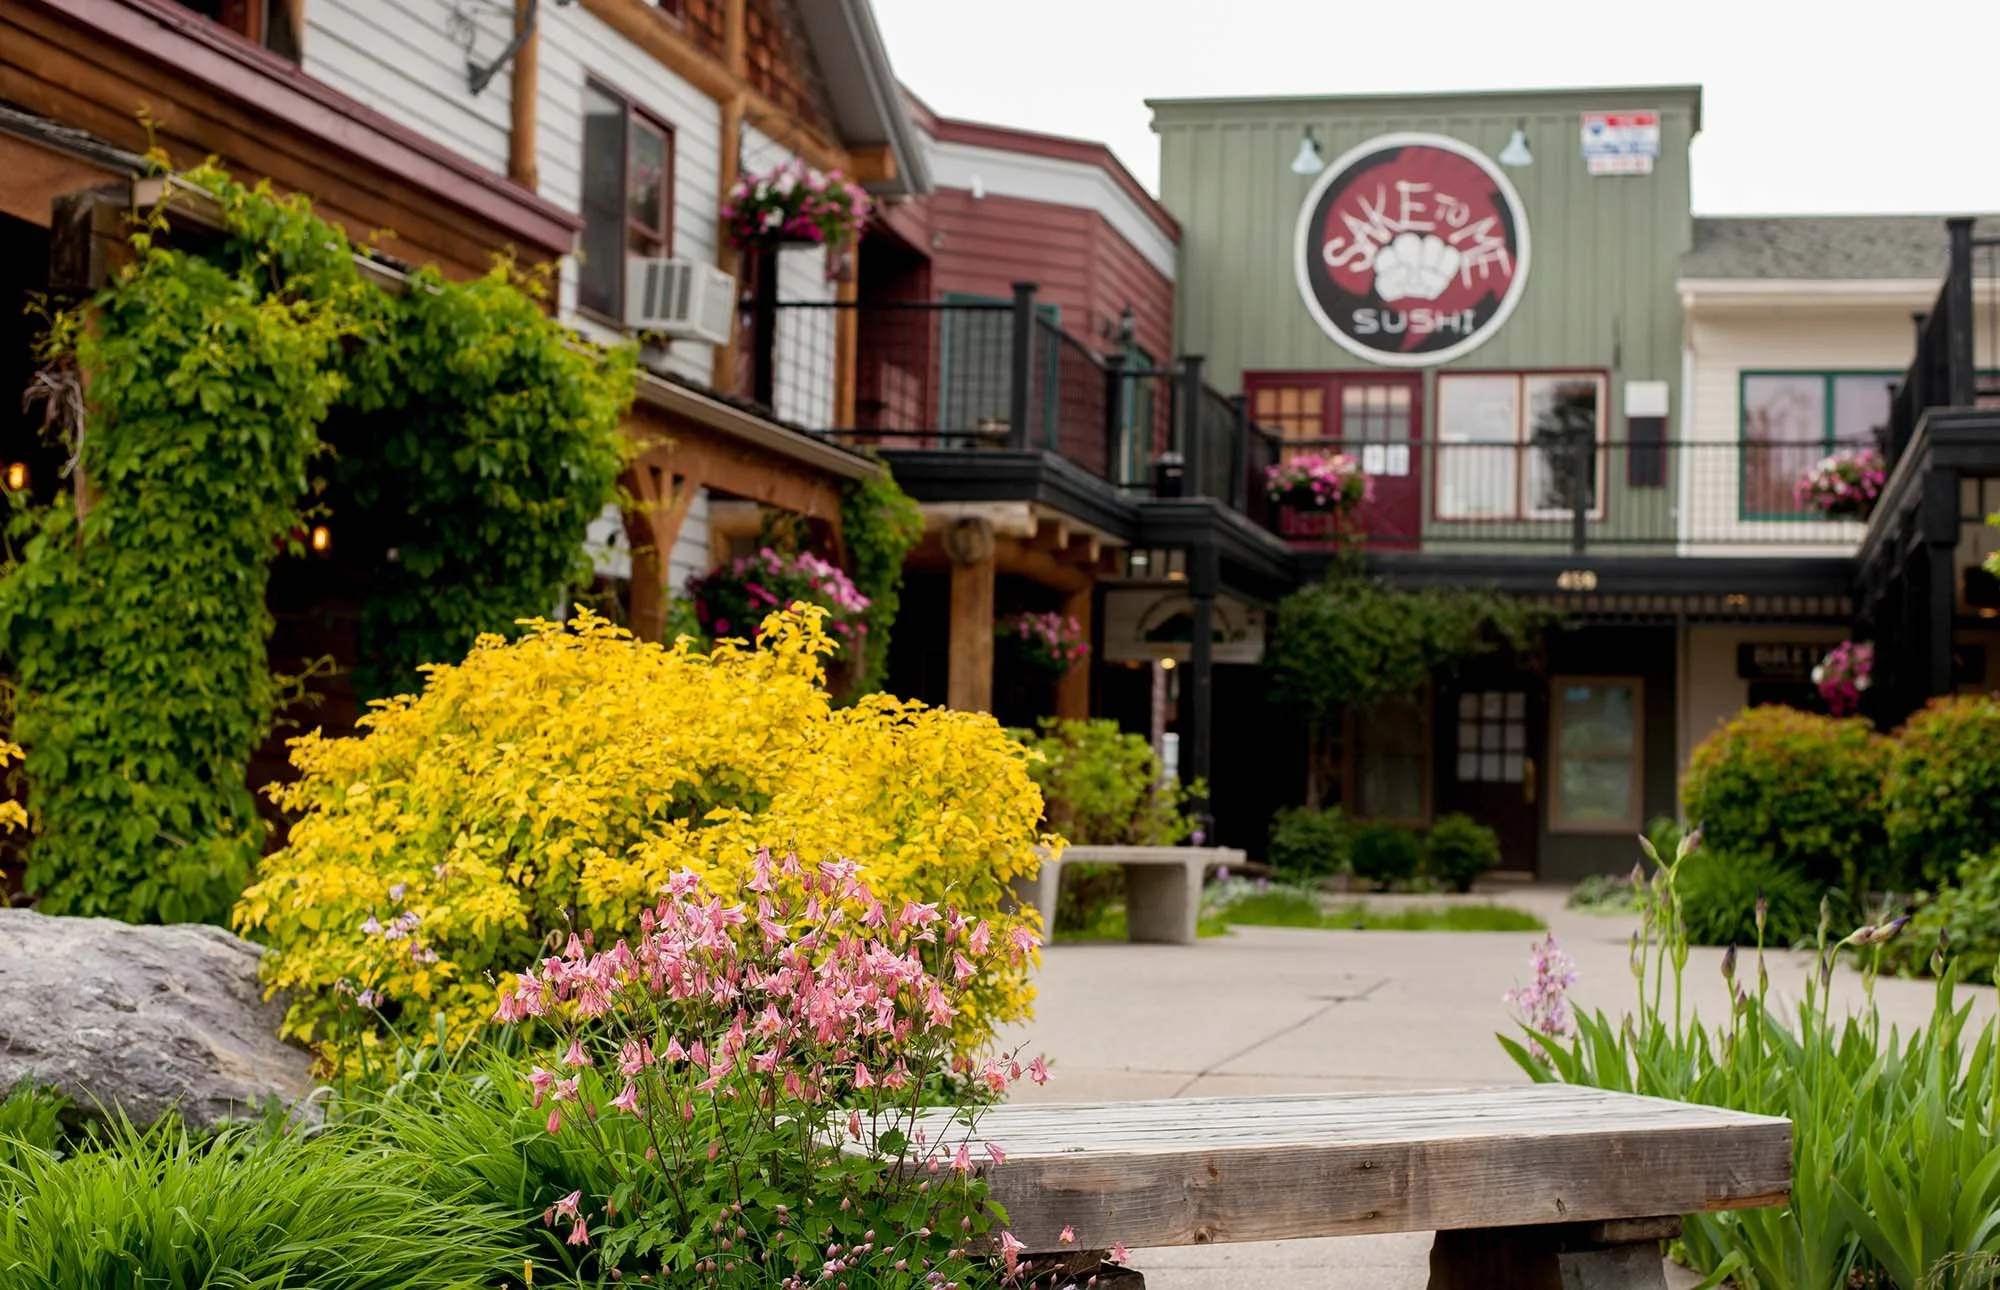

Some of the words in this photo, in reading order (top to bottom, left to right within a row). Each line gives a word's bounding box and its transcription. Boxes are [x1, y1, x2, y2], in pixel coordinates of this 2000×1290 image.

[1323, 180, 1436, 273] SAKE
[1434, 192, 1470, 228] TO
[1449, 216, 1512, 288] ME
[1352, 308, 1476, 334] SUSHI
